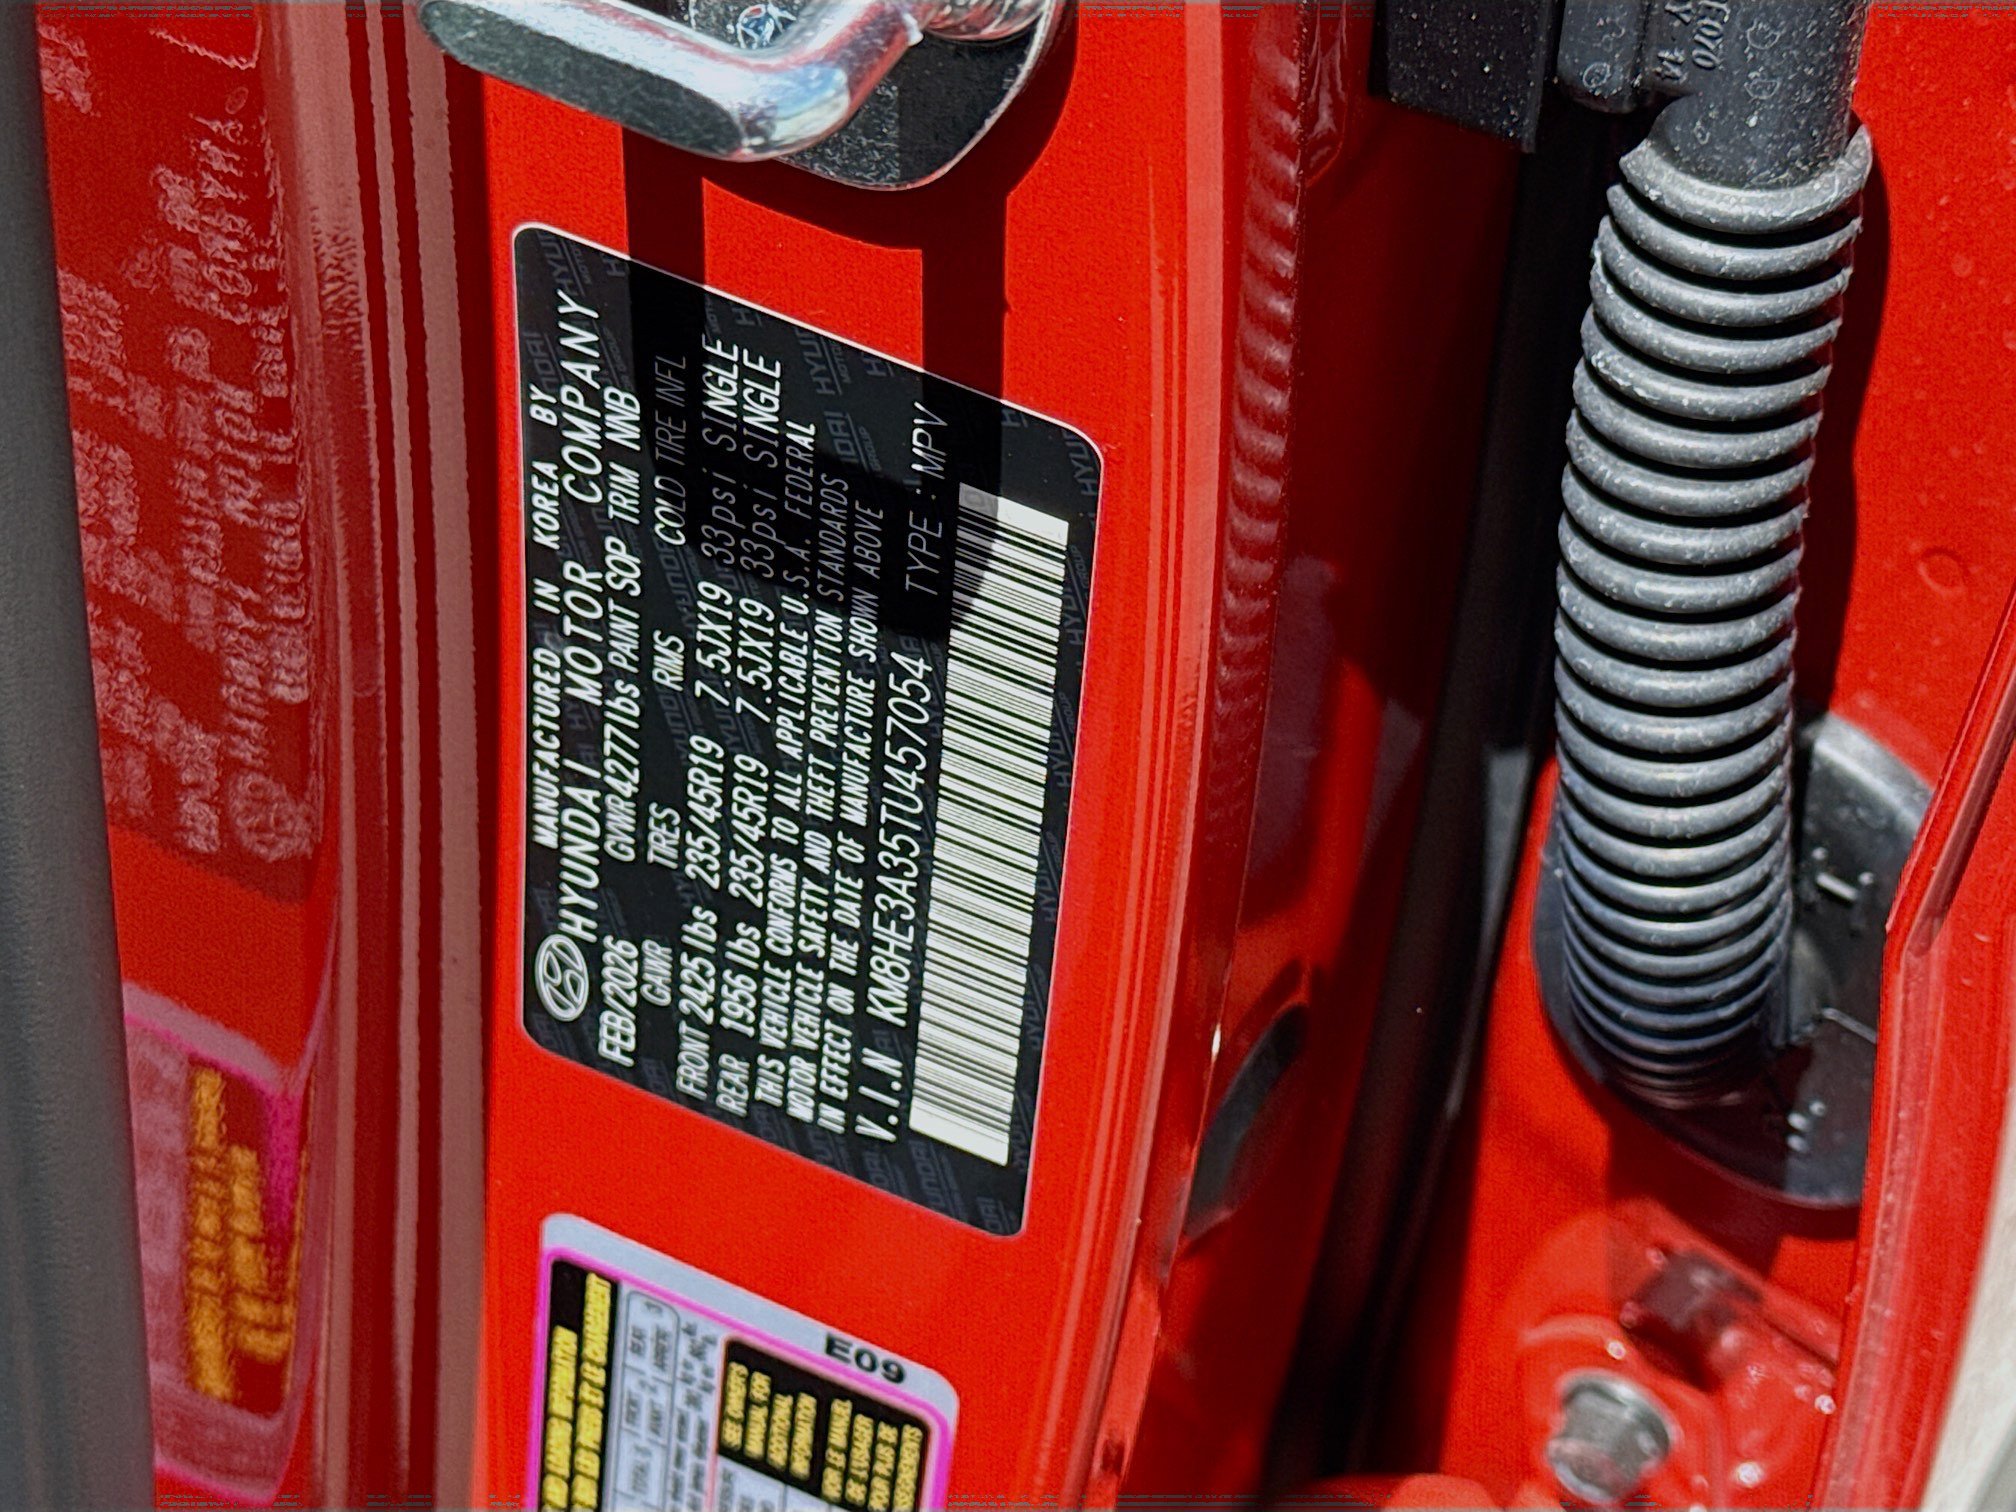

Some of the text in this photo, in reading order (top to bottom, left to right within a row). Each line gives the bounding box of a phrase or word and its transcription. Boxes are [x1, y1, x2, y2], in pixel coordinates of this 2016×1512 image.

[604, 386, 641, 450] NNB
[655, 354, 686, 407] INFL
[701, 334, 738, 452] SINGLE
[742, 348, 781, 468] SINGLE
[655, 410, 686, 466] TIRE
[911, 402, 948, 480] MPV
[608, 461, 641, 524] TRIM
[654, 475, 686, 546] COLD
[604, 536, 641, 597] SOP
[816, 473, 849, 602] STANDARDS
[904, 510, 942, 596] TYPE
[529, 383, 561, 848] MANUFACTURED IN KOREA BY
[557, 290, 604, 942] HYUNDAI MOTOR COMPANY
[607, 597, 640, 674] PAINT
[694, 582, 733, 706] 7.5JX19
[652, 630, 685, 691] RIMS
[735, 598, 774, 722] 7.5JX19
[809, 608, 844, 748] PREVENTION
[754, 420, 816, 1108] THIS VEHICLE CONFORMS TO ALL APPLICABLE U.S.A. FEDERAL
[806, 753, 836, 822] THEFT
[646, 802, 680, 870] TIRES
[685, 735, 724, 890] 235/45R19
[728, 754, 769, 908] 235/45R19
[804, 830, 832, 874] AND
[817, 500, 884, 1134] IN EFFECT ON THE DATE OF MANUFACTURE SHOWN ABOVE
[798, 877, 830, 958] SAFETY
[854, 652, 933, 1142] V.I.N KM8HE3A35TU457054
[598, 935, 638, 1066] FEB/2026
[640, 938, 672, 1006] GAWR
[791, 961, 824, 1050] VEHICLE
[676, 1020, 710, 1100] FRONT
[716, 1054, 750, 1116] REAR
[786, 1055, 817, 1122] MOTOR
[825, 1333, 906, 1385] E09
